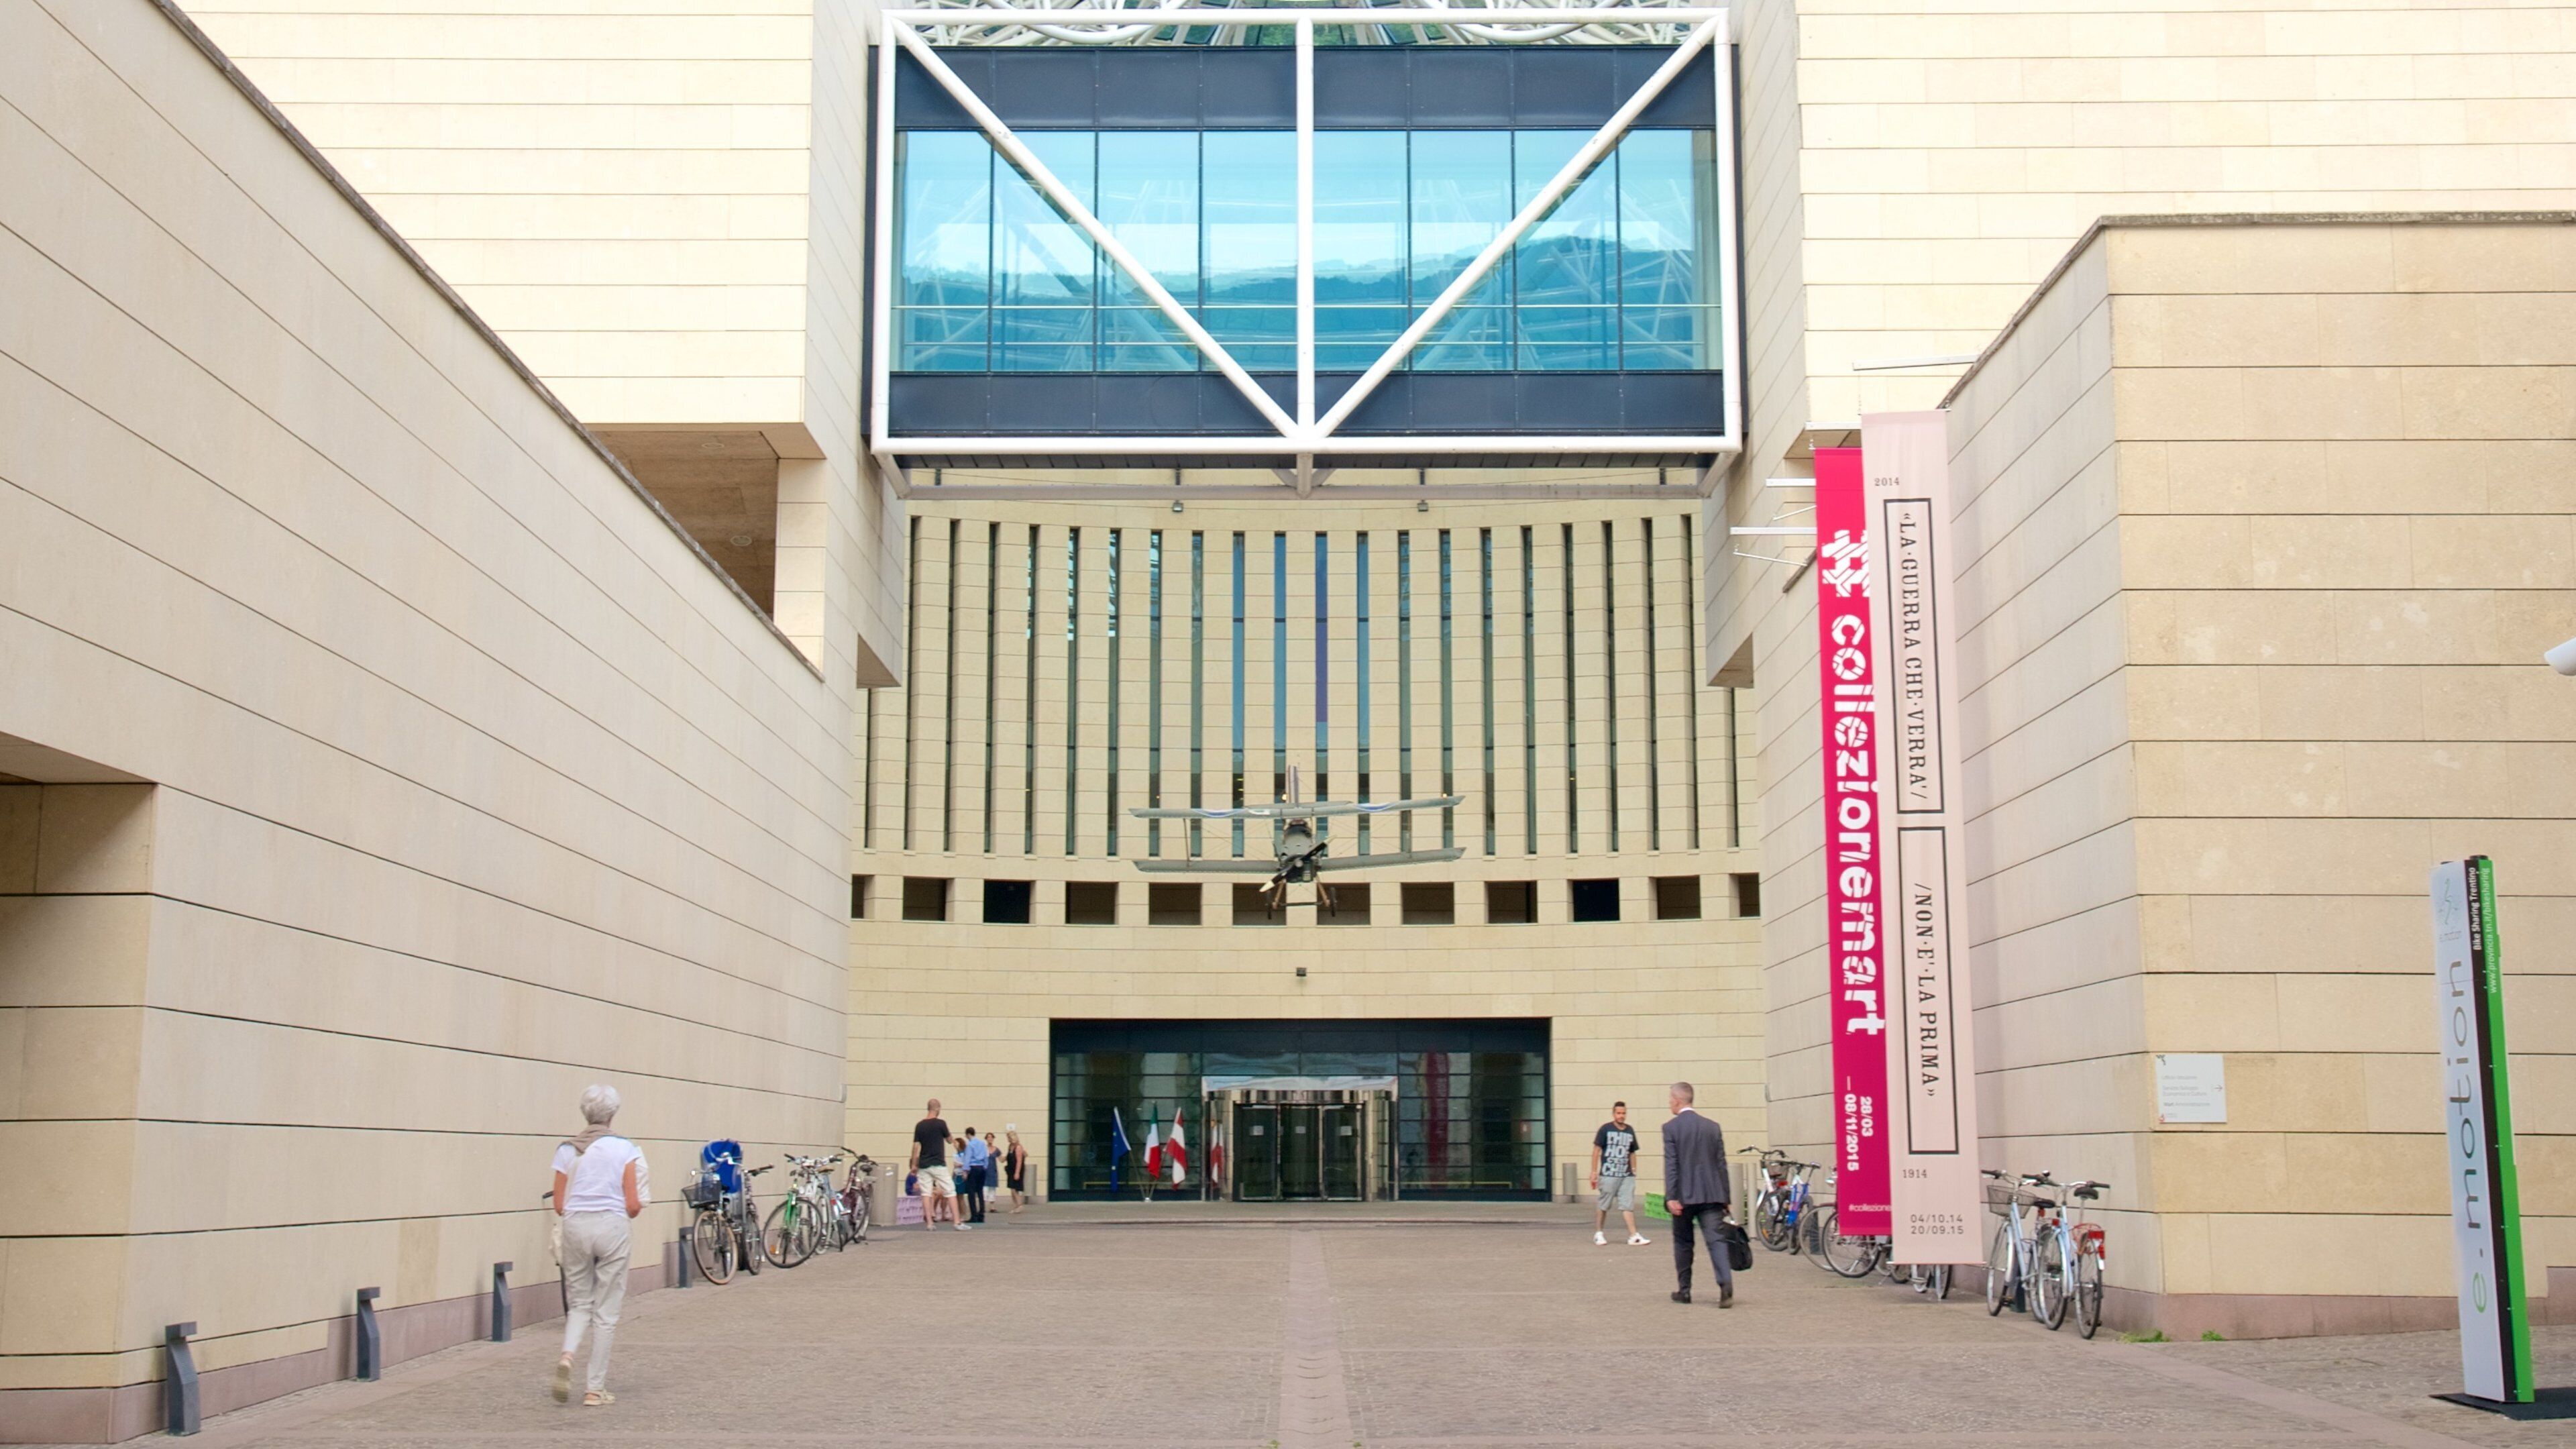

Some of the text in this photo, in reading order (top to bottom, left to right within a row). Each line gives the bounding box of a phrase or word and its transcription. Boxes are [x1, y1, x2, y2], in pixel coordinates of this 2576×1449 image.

[1874, 477, 1900, 486] 2014
[2469, 867, 2482, 951] Bike Sharing Trentino
[1860, 1095, 1874, 1137] 28/03
[1902, 1169, 1927, 1179] 1914
[1910, 1214, 1964, 1223] 04/10.14
[1911, 1225, 1964, 1235] 20/09.15
